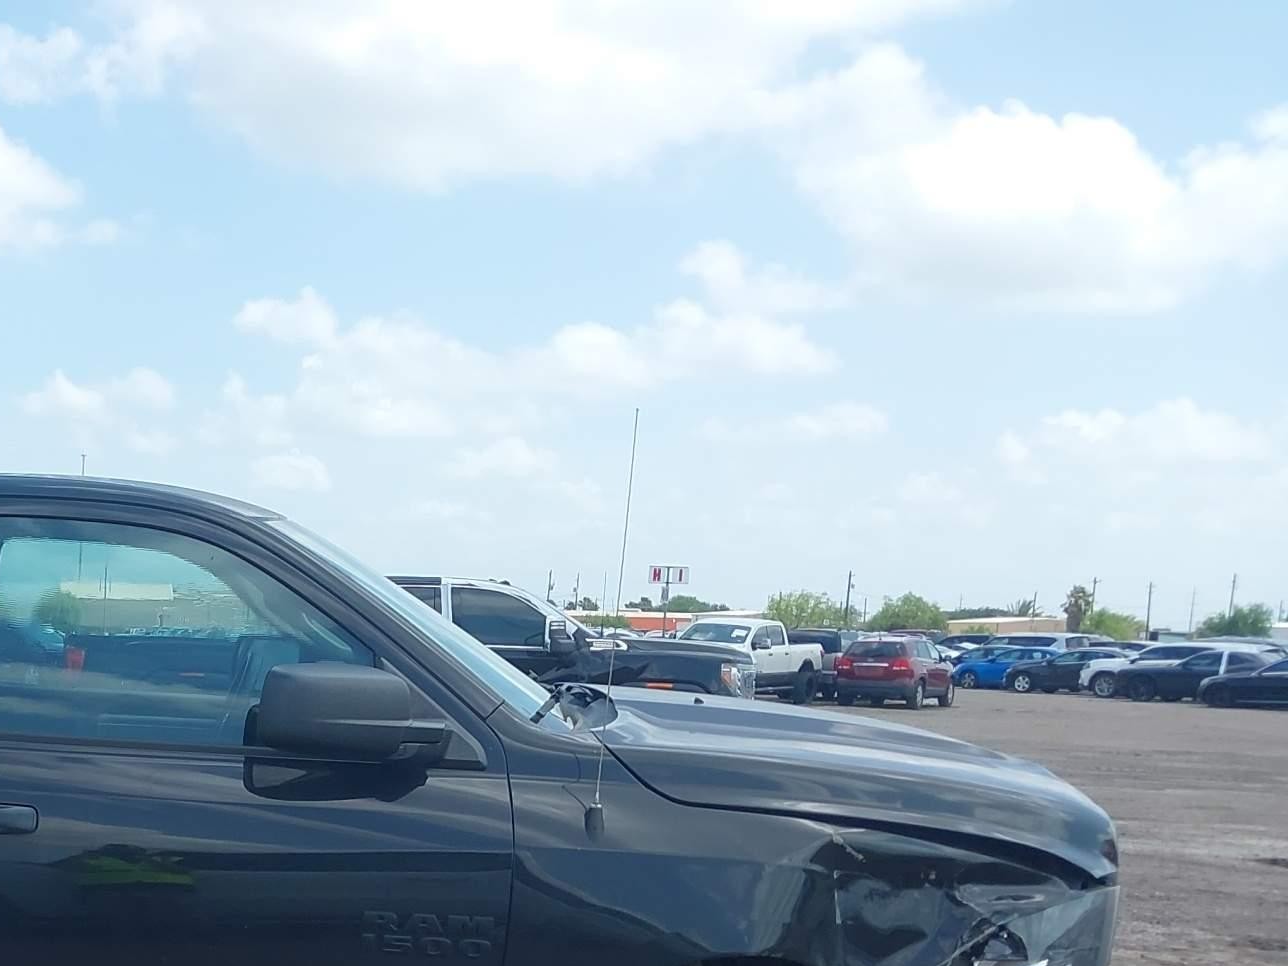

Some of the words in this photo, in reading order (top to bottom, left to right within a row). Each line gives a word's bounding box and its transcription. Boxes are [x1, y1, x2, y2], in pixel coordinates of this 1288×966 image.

[652, 567, 662, 582] H
[361, 910, 496, 935] RAM
[361, 933, 494, 958] 1500
